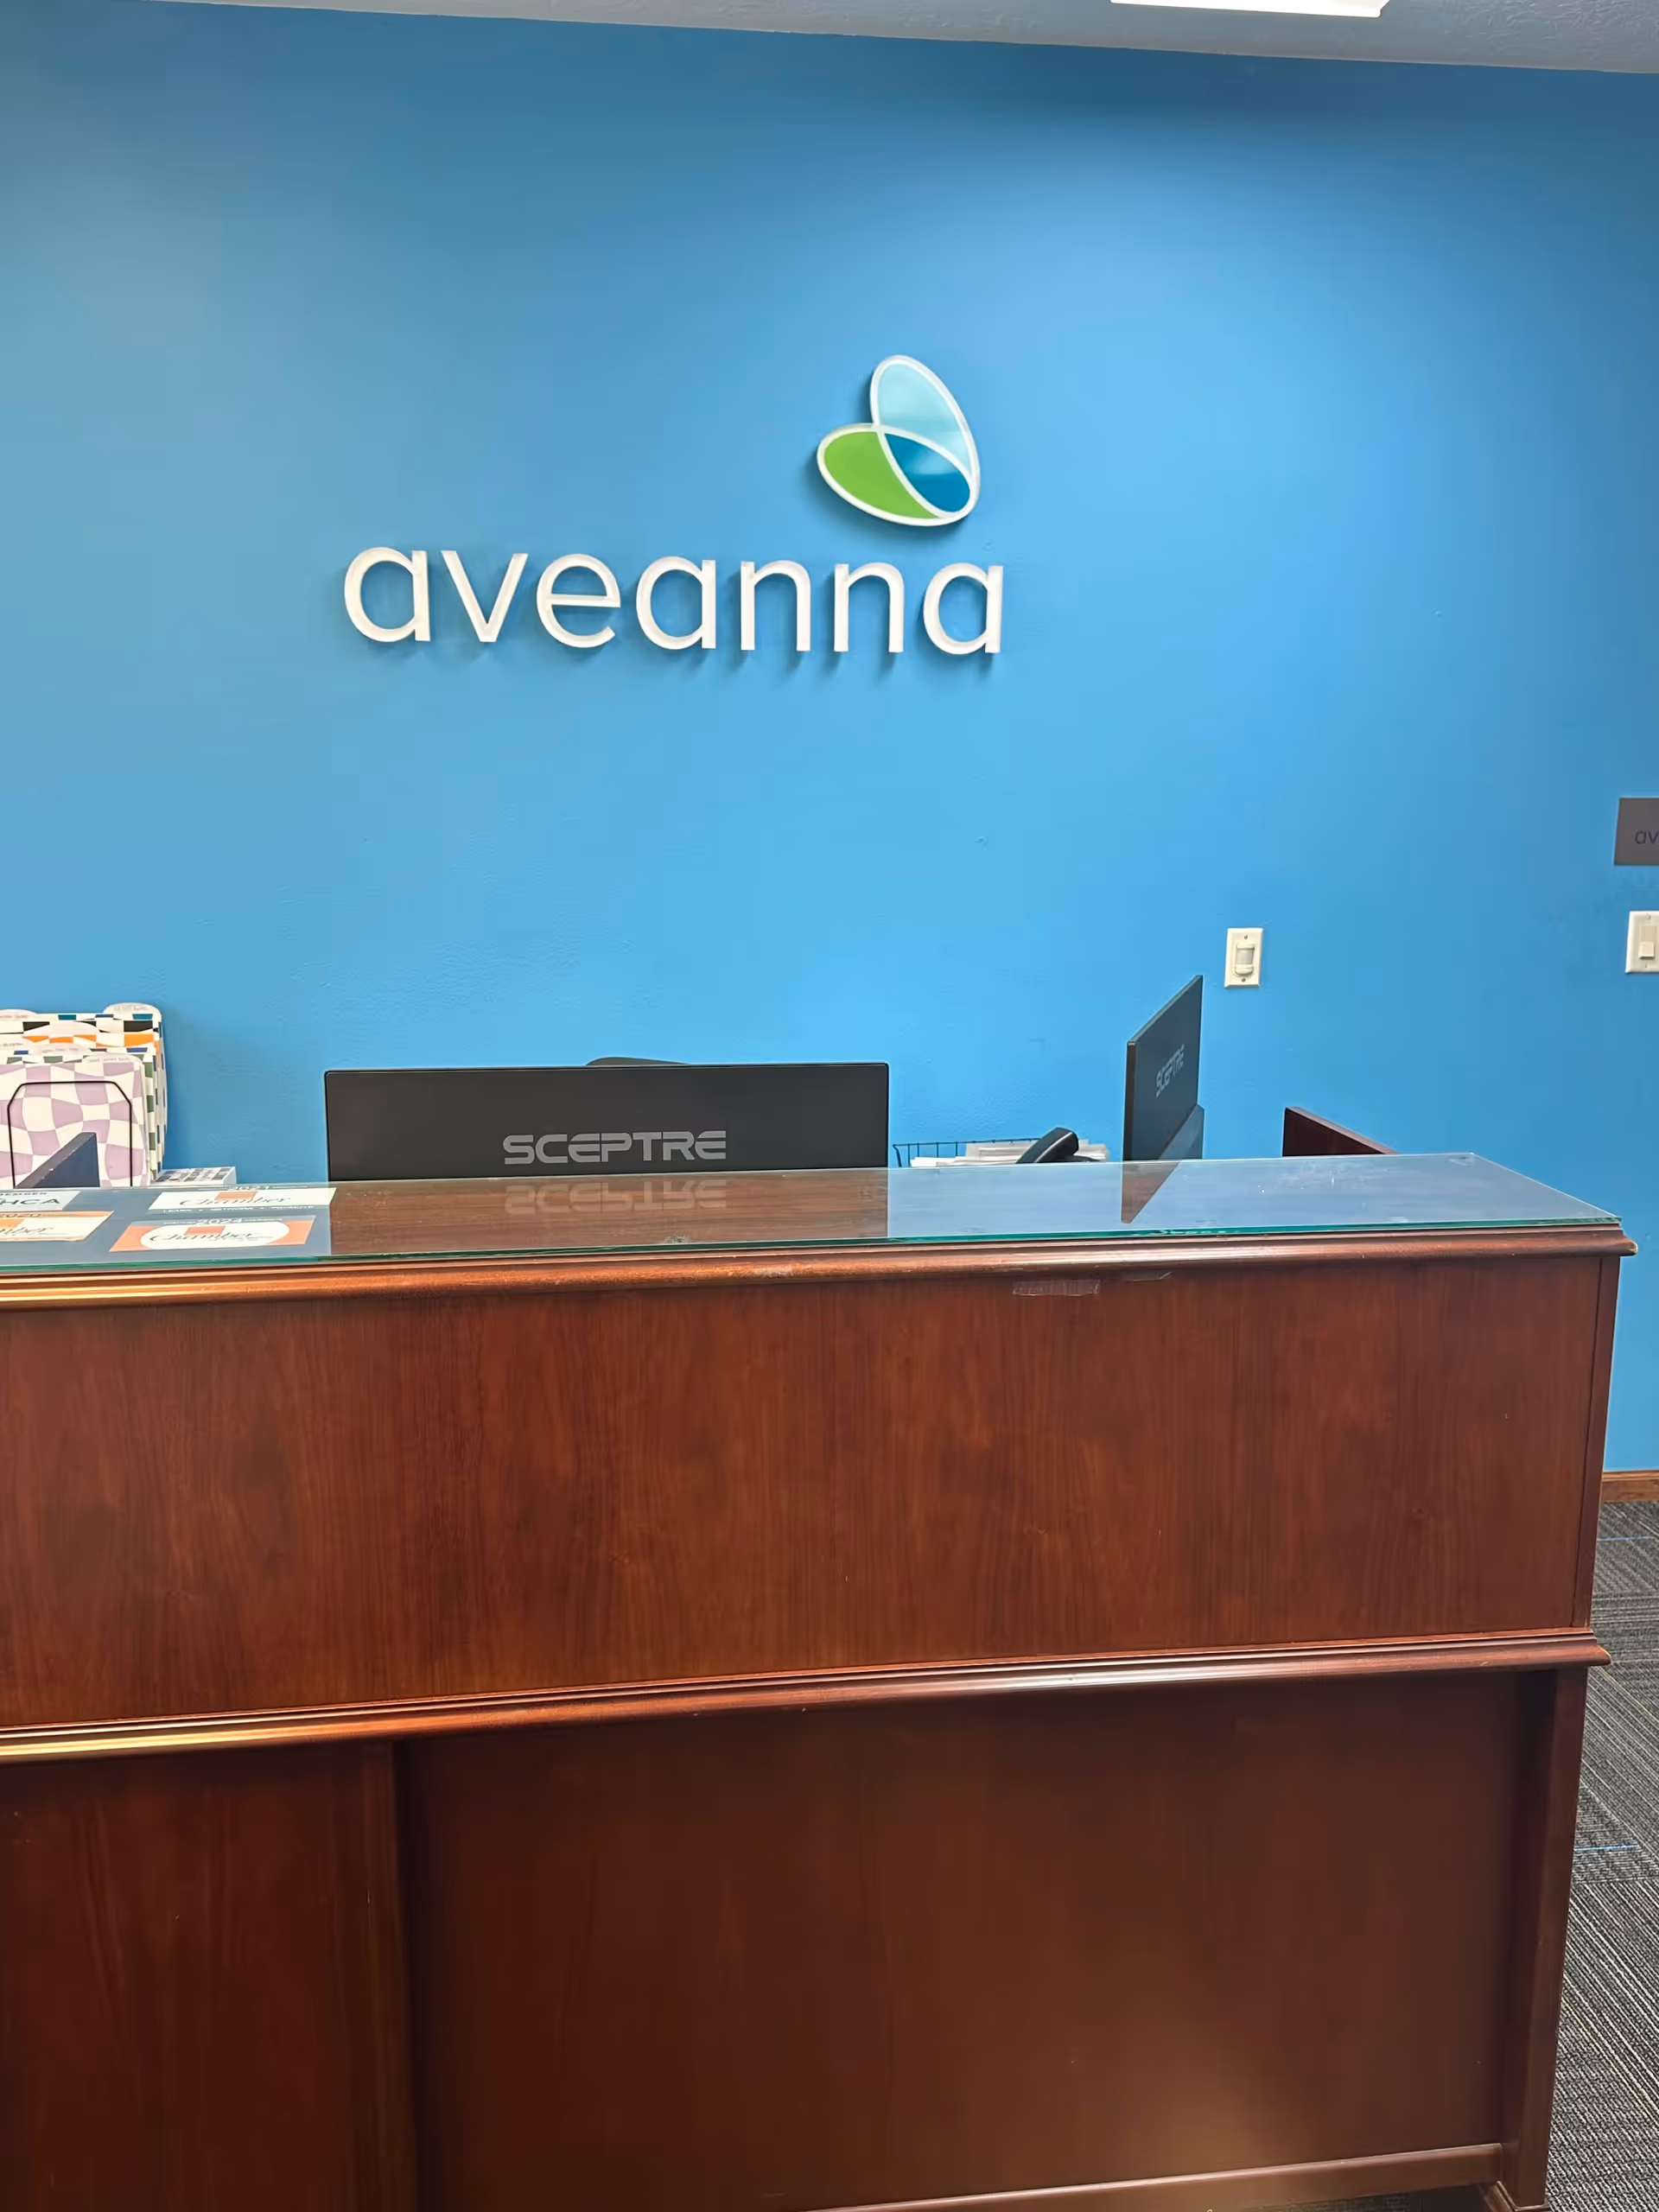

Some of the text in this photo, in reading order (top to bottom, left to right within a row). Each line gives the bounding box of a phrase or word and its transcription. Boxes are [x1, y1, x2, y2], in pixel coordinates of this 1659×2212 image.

[344, 547, 1003, 655] aveanna
[503, 1130, 727, 1165] SCEPTRE
[149, 1231, 257, 1242] Chamber
